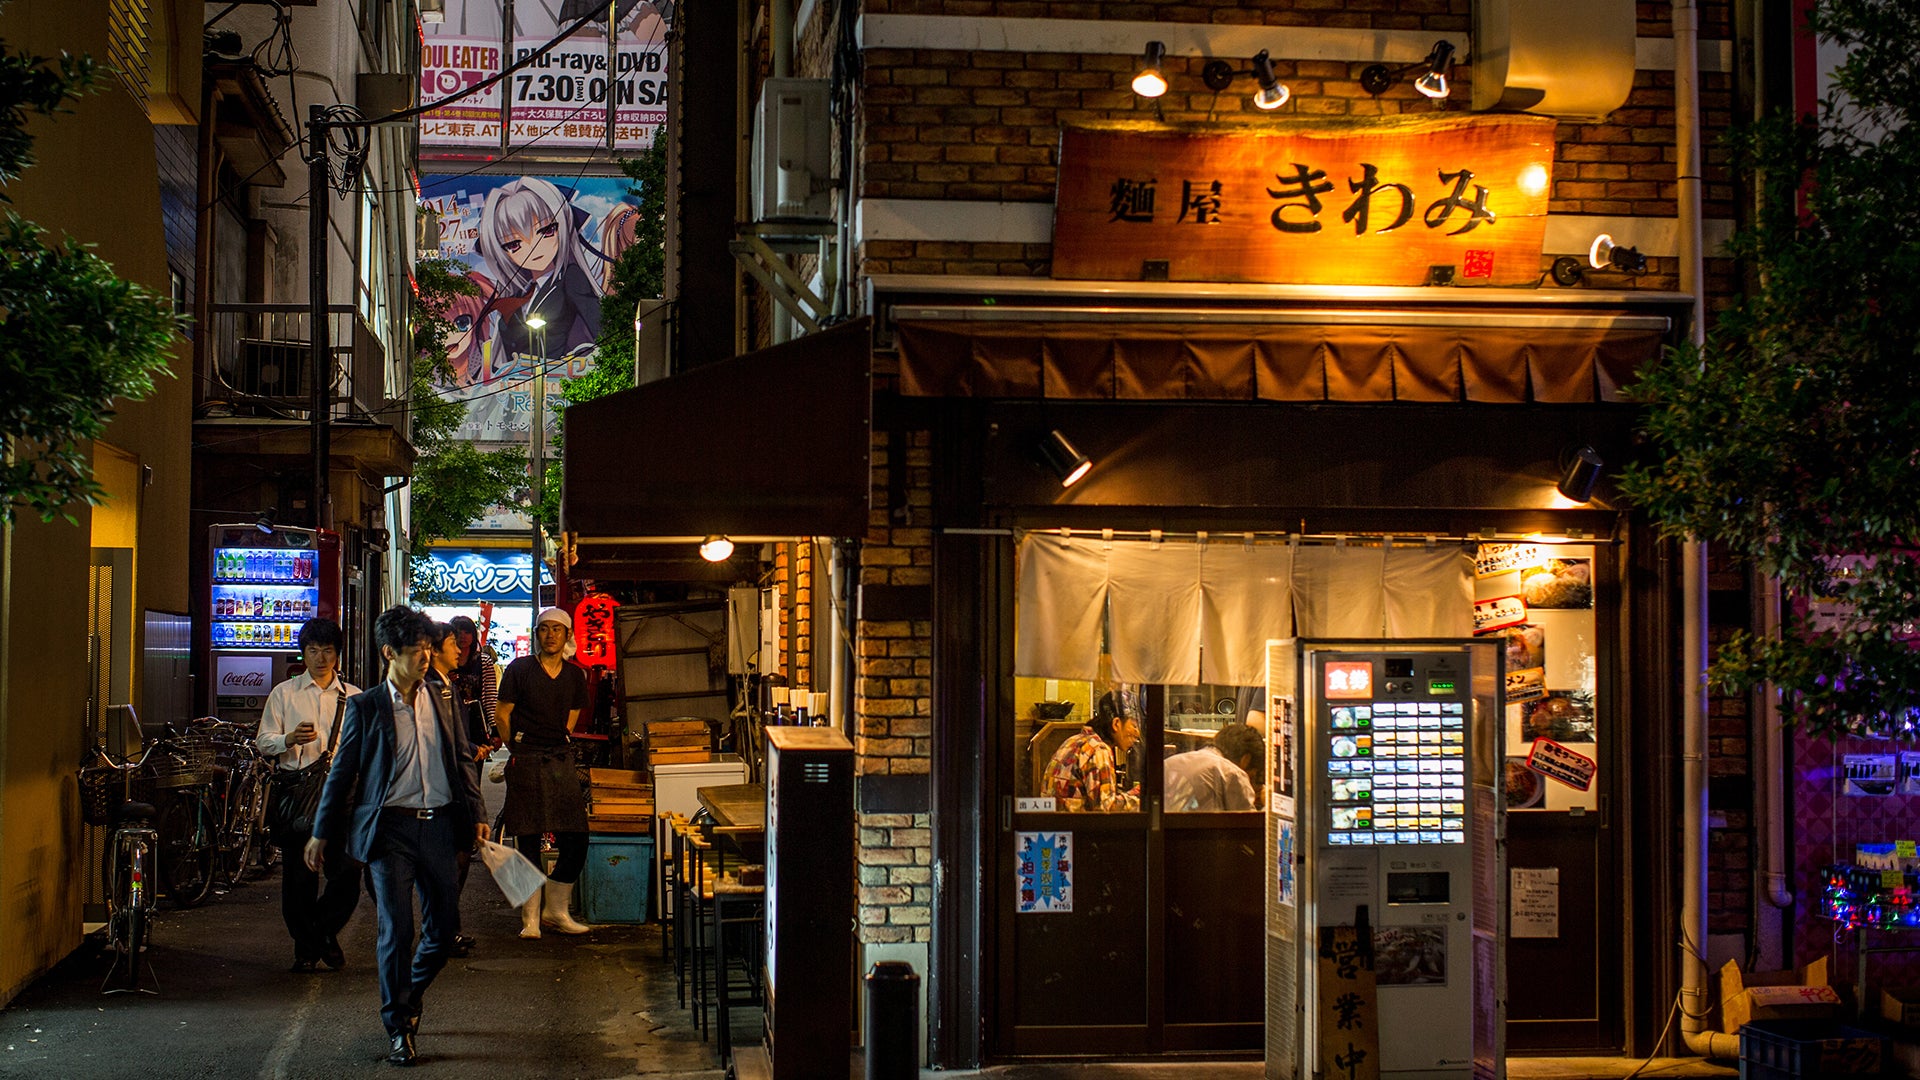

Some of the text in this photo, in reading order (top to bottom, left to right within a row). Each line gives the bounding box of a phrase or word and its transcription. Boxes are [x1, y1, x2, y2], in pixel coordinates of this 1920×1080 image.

[452, 46, 499, 71] EATER
[617, 52, 660, 73] DVD
[517, 76, 573, 101] 7.30
[1265, 162, 1497, 237] きわみ
[582, 603, 610, 658] やきとり
[222, 672, 264, 687] Coca-Cola
[1327, 668, 1369, 691] 食券
[1019, 801, 1052, 810] 出入口
